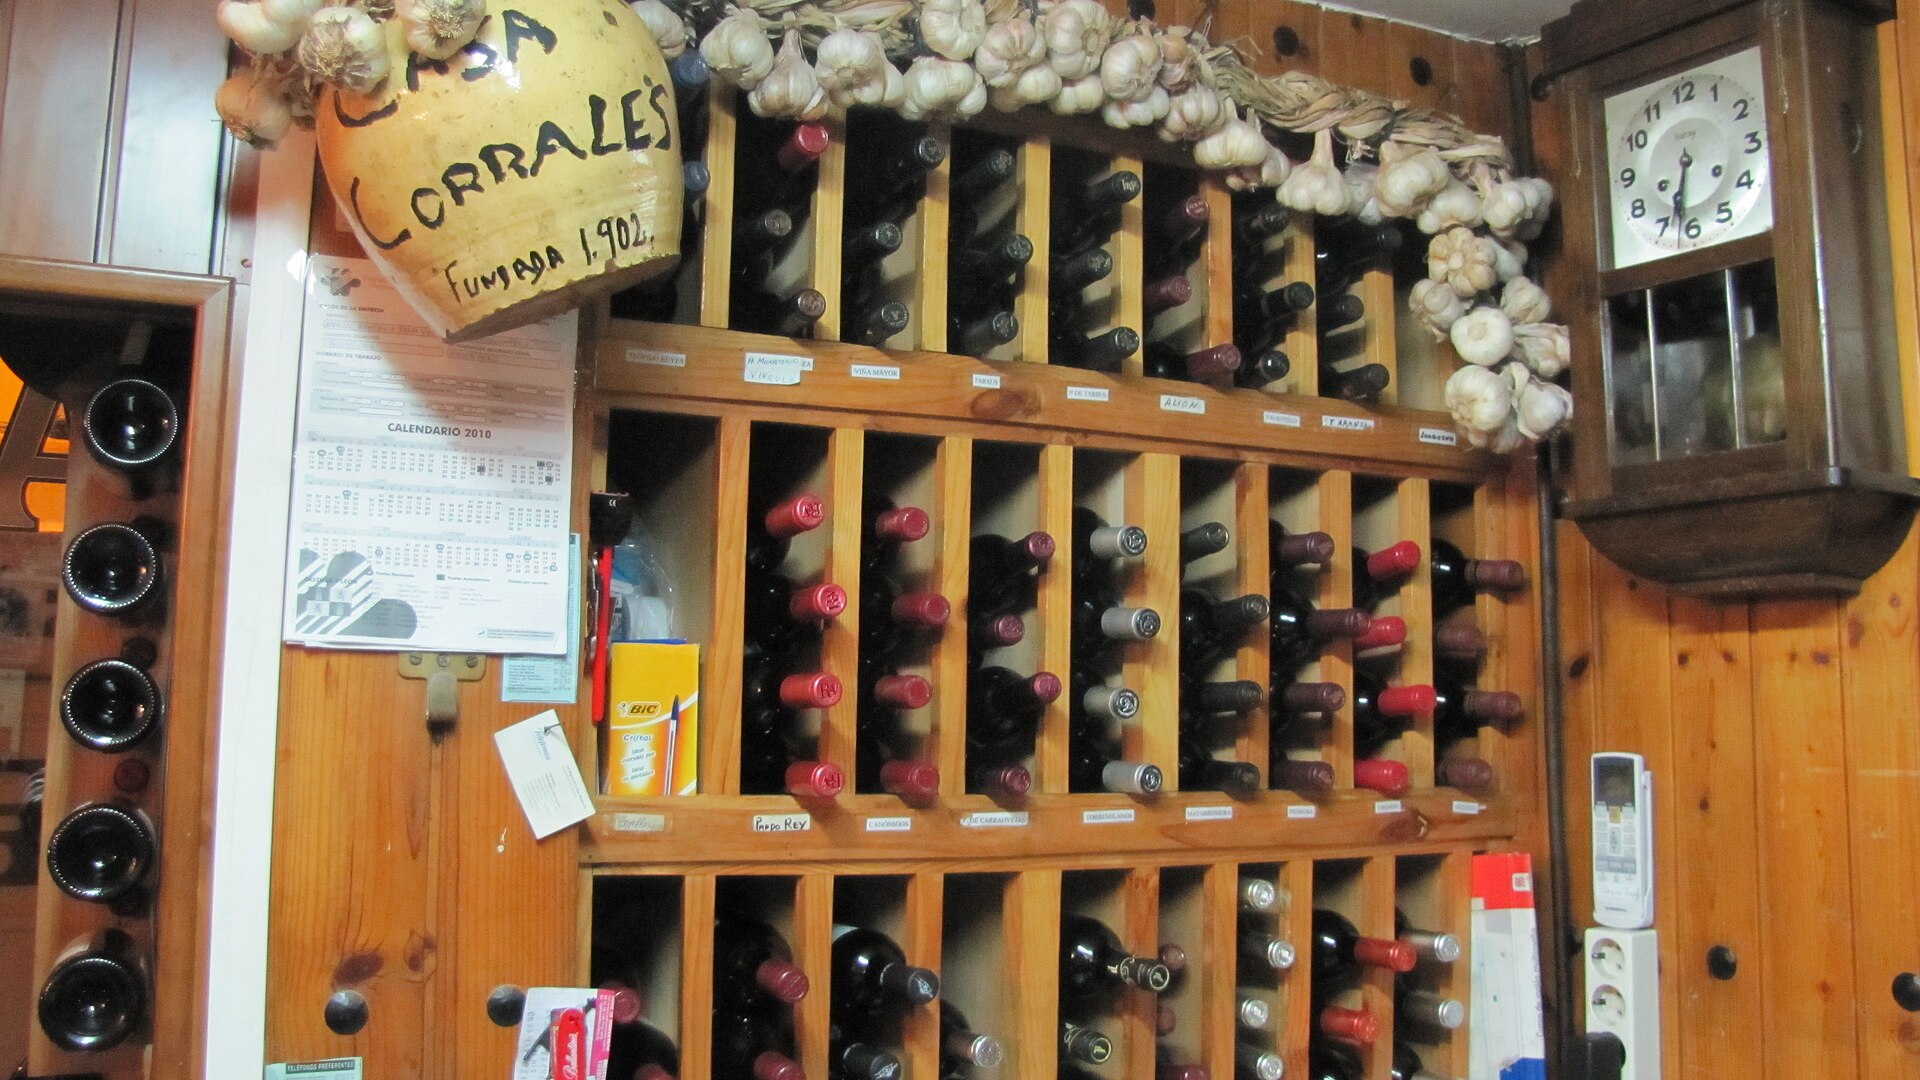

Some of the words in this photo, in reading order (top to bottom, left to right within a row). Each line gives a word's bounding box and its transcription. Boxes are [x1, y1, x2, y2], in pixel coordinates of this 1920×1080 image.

[1672, 81, 1696, 104] 12
[1709, 83, 1719, 103] 1
[1643, 102, 1661, 123] 11
[1733, 99, 1749, 122] 2
[1626, 129, 1648, 152] 10
[1744, 130, 1762, 154] 3
[1620, 167, 1636, 188] 9
[1735, 169, 1755, 190] 4
[1630, 198, 1646, 219] 8
[1715, 200, 1733, 223] 5
[1655, 216, 1671, 237] 7
[1684, 217, 1702, 239] 6
[872, 368, 898, 377] MAYOR
[387, 422, 461, 437] CALENDARIO
[464, 428, 492, 439] 2010
[784, 816, 807, 830] REY
